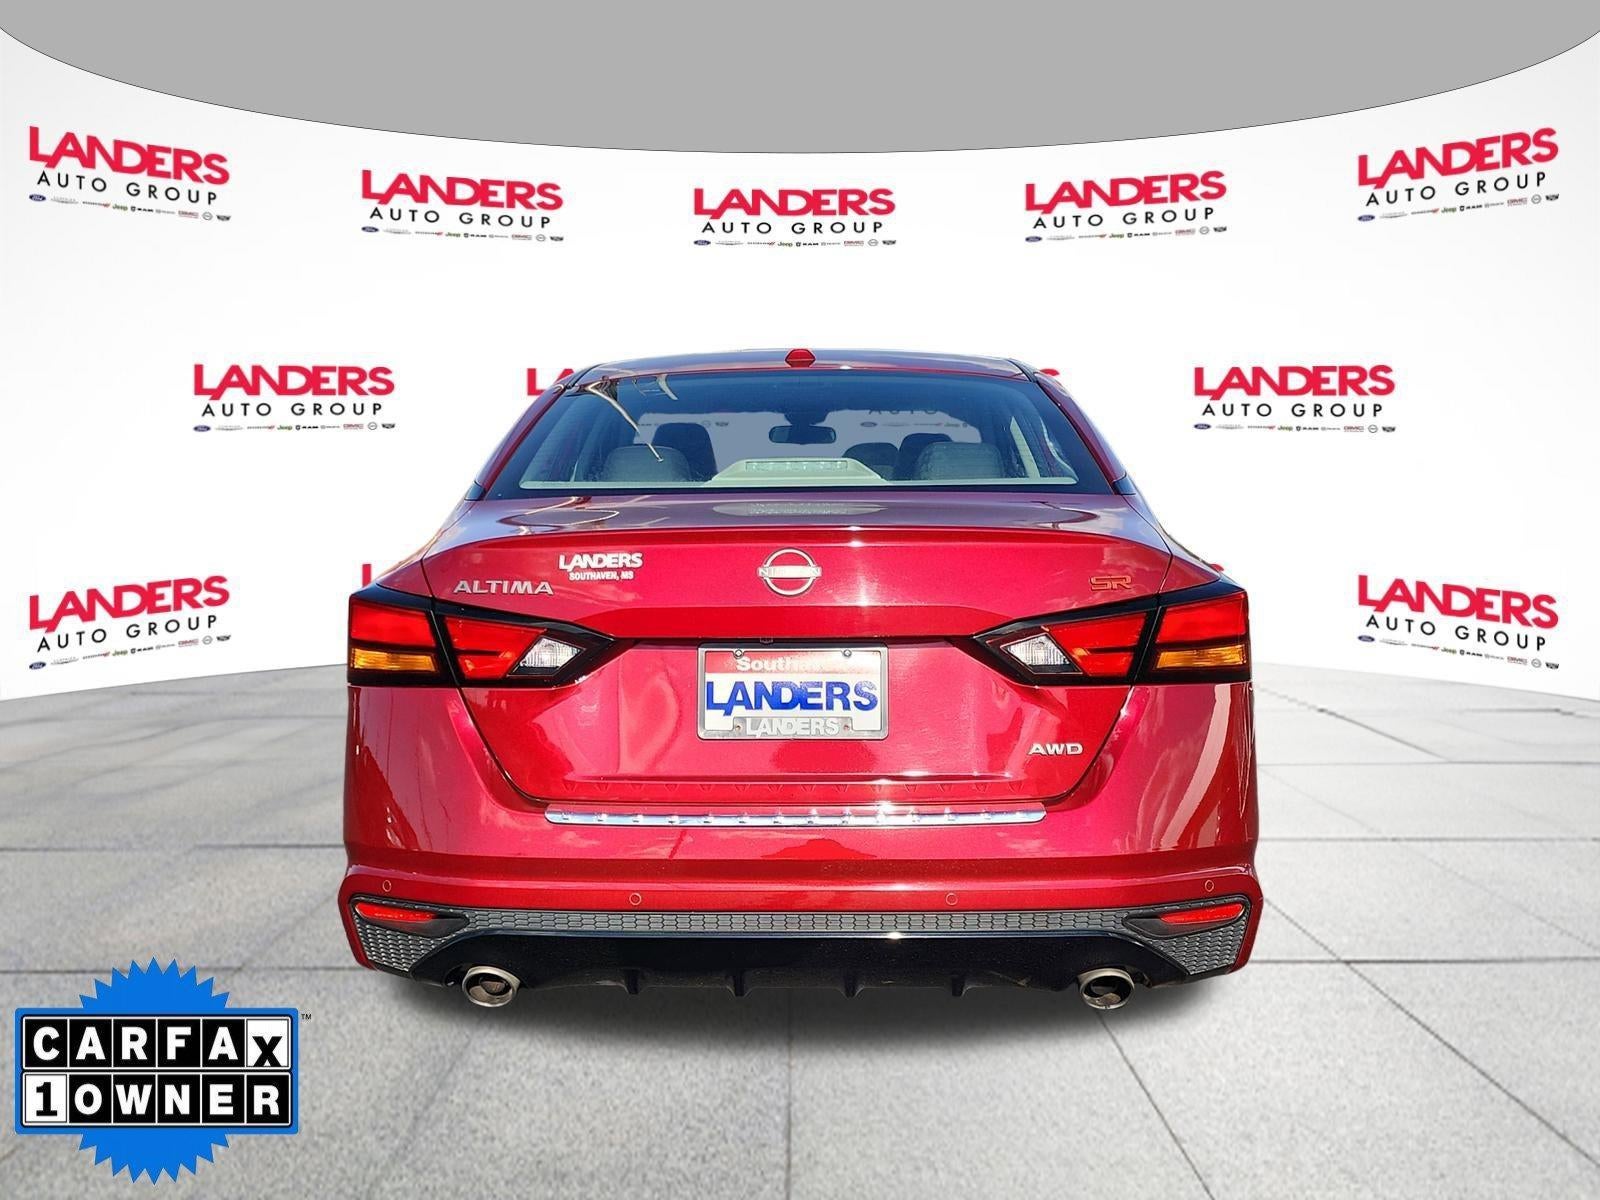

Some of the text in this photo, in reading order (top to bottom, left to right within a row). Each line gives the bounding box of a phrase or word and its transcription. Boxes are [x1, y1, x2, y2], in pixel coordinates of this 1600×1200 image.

[29, 126, 230, 185] LANDERS
[1357, 127, 1559, 190] LANDERS
[36, 170, 107, 193] AUTO
[126, 182, 217, 205] GROUP
[361, 169, 564, 211] LANDERS
[693, 187, 896, 220] LANDERS
[1025, 170, 1227, 215] LANDERS
[1365, 171, 1546, 207] AUTO GROUP
[369, 206, 550, 229] AUTO GROUP
[701, 221, 883, 235] AUTO GROUP
[1033, 207, 1214, 229] AUTO GROUP
[193, 363, 395, 401] LANDERS
[1193, 364, 1396, 401] LANDERS
[201, 402, 382, 417] AUTO GROUP
[1202, 403, 1383, 418] AUTO GROUP
[559, 552, 643, 571] LANDERS
[569, 571, 634, 581] SOUTHAVEN, MS
[453, 580, 554, 595] ALTIMA
[1089, 575, 1132, 590] SR
[29, 575, 230, 633] LANDERS
[1357, 575, 1559, 629] LANDERS
[37, 614, 217, 653] AUTO GROUP
[1366, 614, 1436, 636] AUTO
[1454, 625, 1546, 651] GROUP
[706, 681, 878, 716] LANDERS
[746, 718, 840, 737] LANDERS
[1028, 743, 1083, 755] AWD
